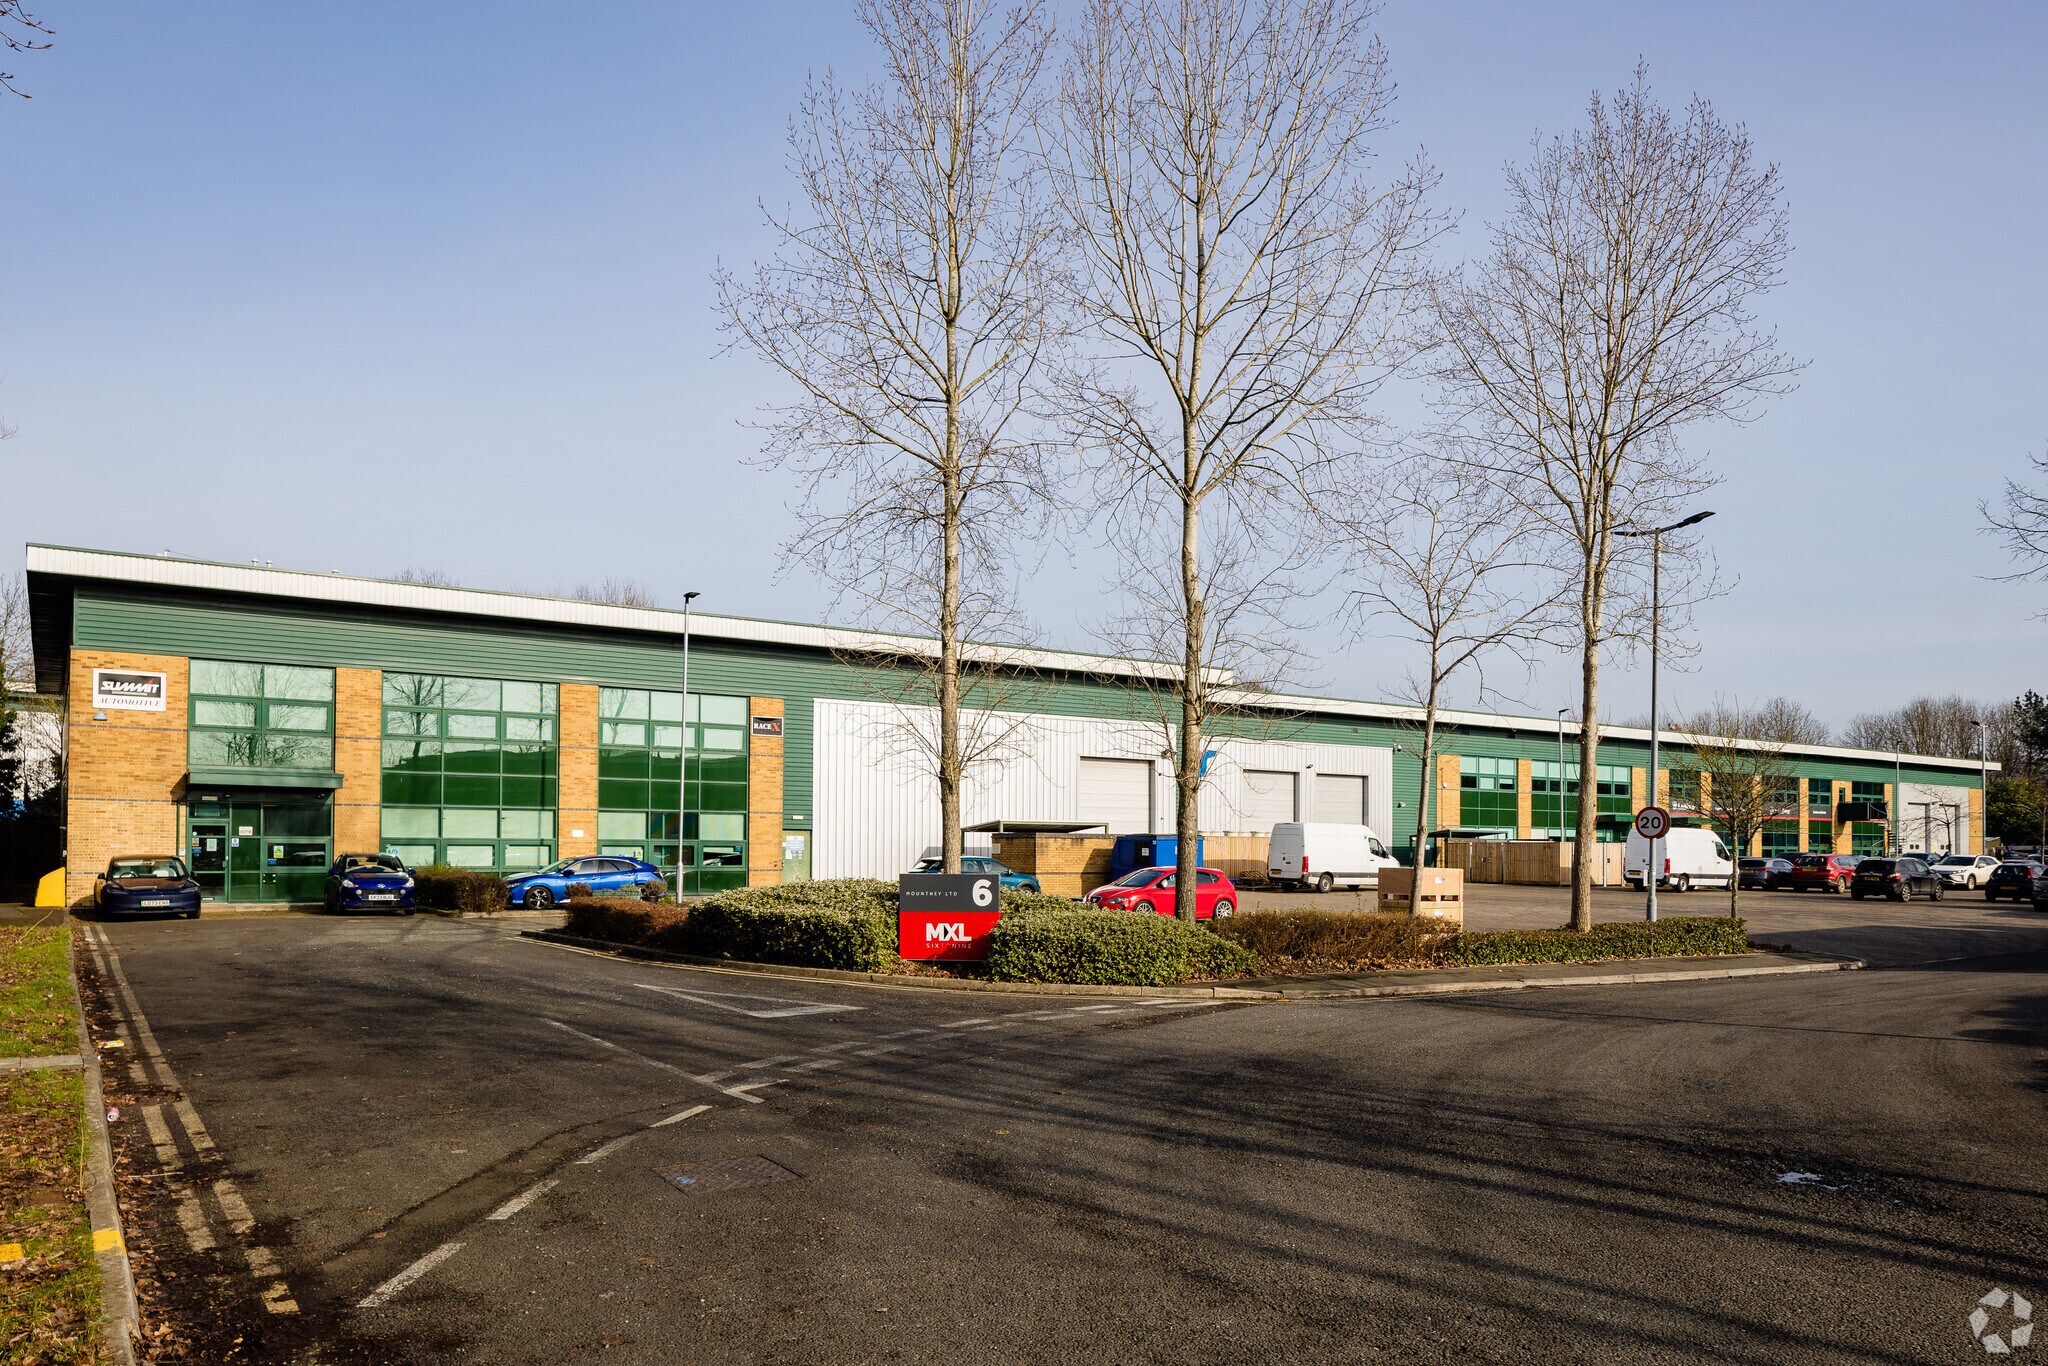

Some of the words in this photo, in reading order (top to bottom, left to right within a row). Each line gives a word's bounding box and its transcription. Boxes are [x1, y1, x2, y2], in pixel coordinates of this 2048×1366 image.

[101, 680, 159, 693] SUMMIT
[99, 698, 161, 707] AUTOMOTIVE
[1640, 816, 1661, 829] 20
[972, 879, 993, 907] 6
[926, 923, 972, 941] MXL
